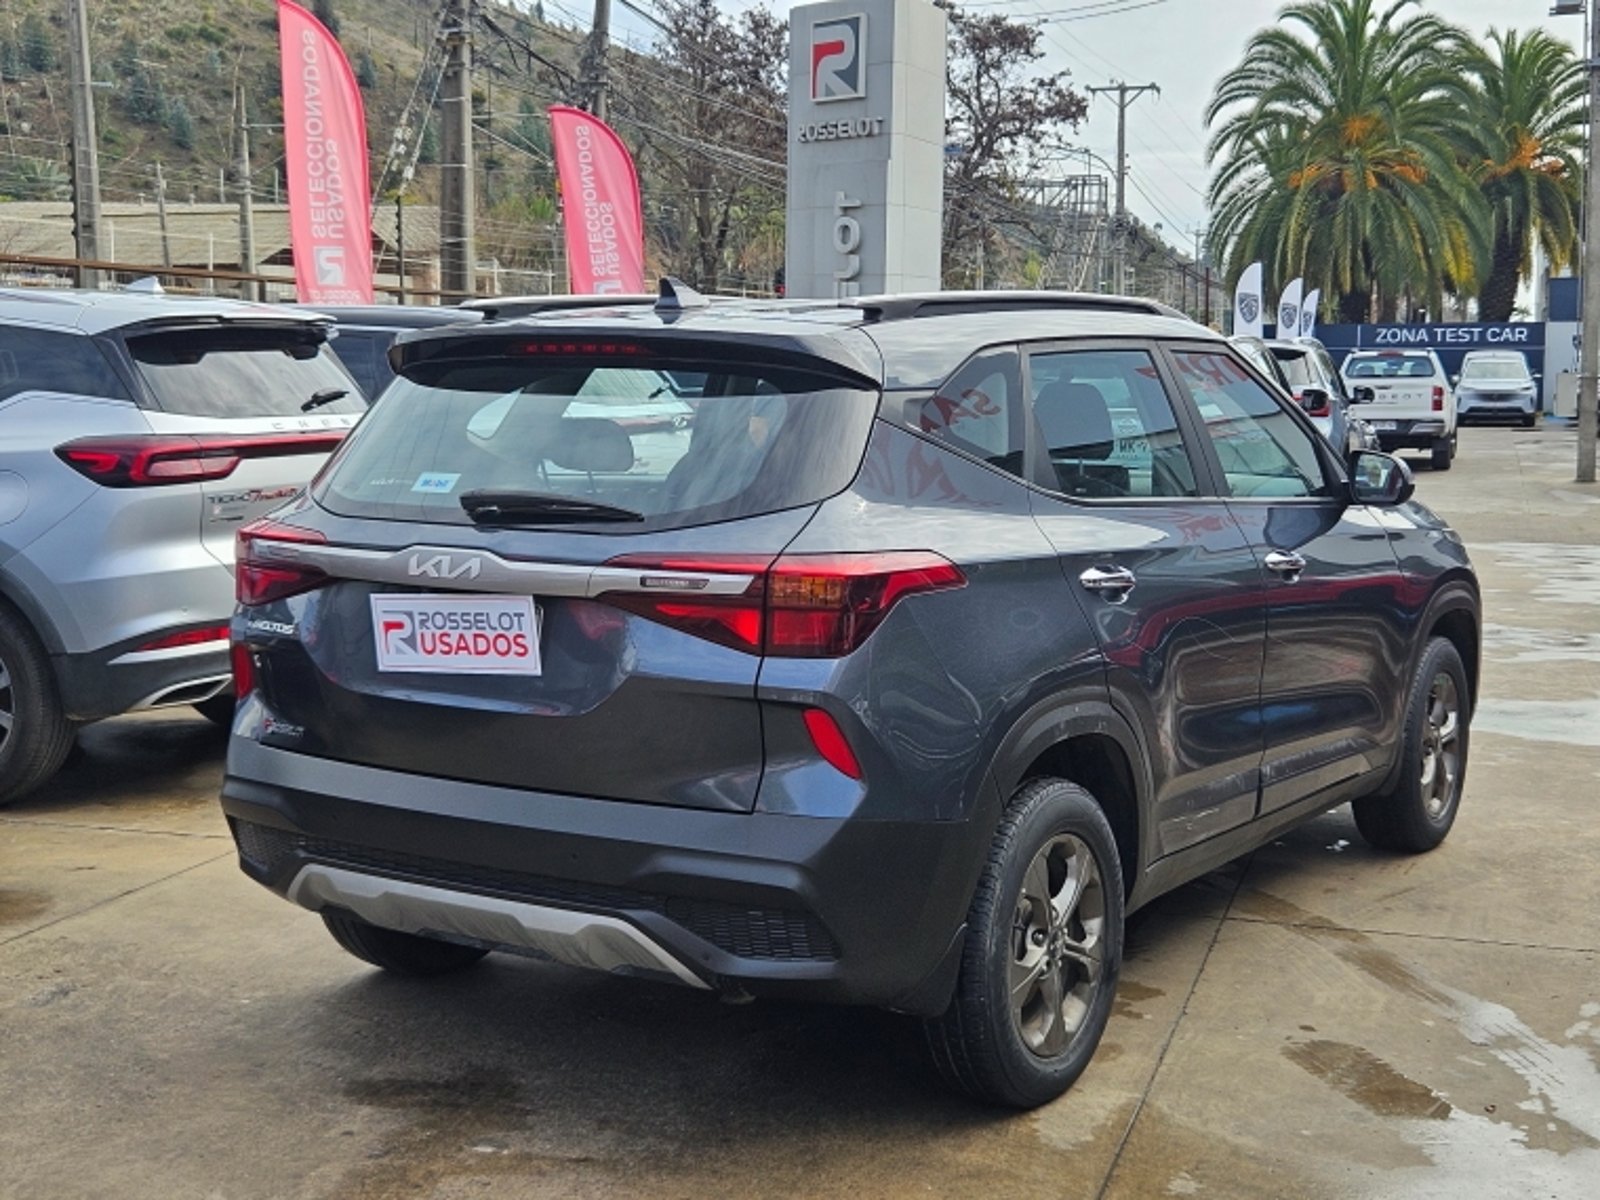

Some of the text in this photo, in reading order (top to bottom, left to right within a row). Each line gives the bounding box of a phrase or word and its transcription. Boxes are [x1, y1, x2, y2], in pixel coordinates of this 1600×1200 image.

[798, 117, 884, 143] ROSSELOT
[1376, 327, 1528, 343] ZONA TEST CAR
[407, 553, 481, 580] KIA
[418, 611, 525, 632] ROSSELOT
[420, 632, 529, 657] USADOS
